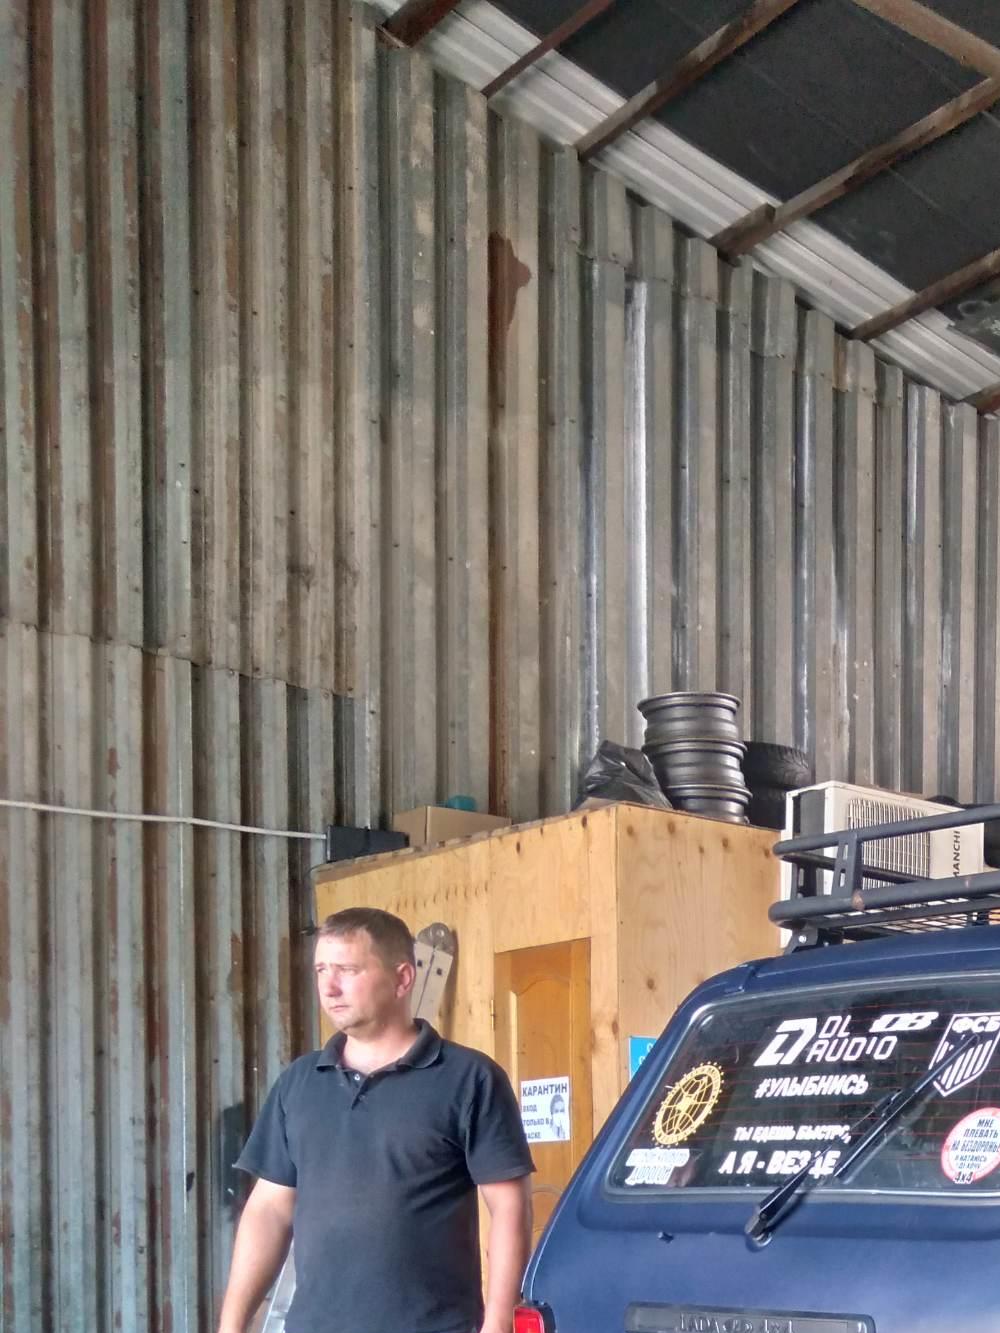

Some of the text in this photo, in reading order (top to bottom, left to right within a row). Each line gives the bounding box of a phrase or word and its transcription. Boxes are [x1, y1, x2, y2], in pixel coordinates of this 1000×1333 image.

[806, 1035, 898, 1063] AUDIO
[522, 1082, 568, 1097] КАРАНТИН
[755, 1074, 869, 1098] #УЛЫБНИСЬ
[977, 1119, 994, 1128] МНЕ
[963, 1128, 999, 1138] ПЛЕВАТЬ
[951, 1140, 961, 1151] НА
